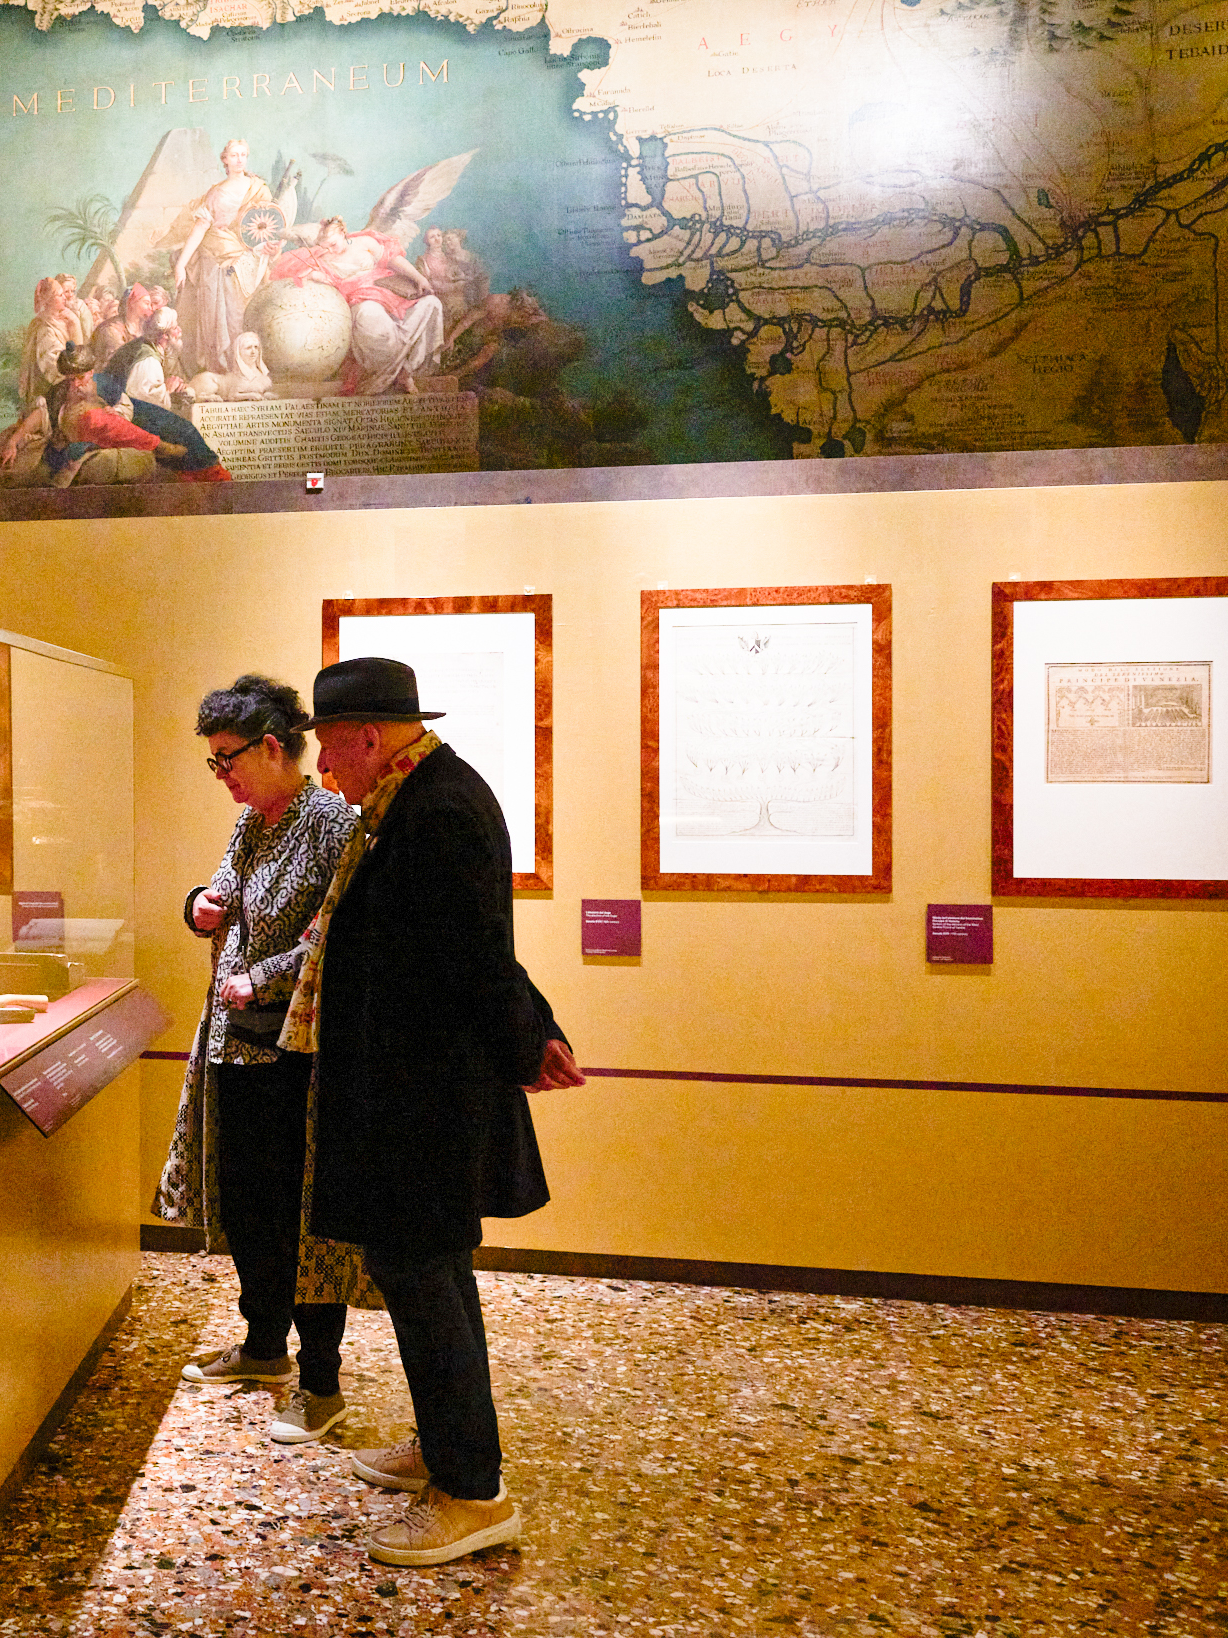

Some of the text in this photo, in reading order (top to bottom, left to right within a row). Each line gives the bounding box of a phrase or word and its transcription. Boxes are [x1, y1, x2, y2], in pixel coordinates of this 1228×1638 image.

[12, 58, 450, 117] MEDITERRANEUM
[199, 405, 229, 414] TABULA
[251, 403, 282, 413] SYRIAM
[200, 421, 244, 431] AEGYPTIAE
[246, 420, 269, 429] ARTIS
[271, 419, 322, 428] MONUMENTA
[213, 430, 236, 438] ASIAM
[217, 447, 256, 456] AEGYPTUM
[221, 455, 257, 463] ANDREAS
